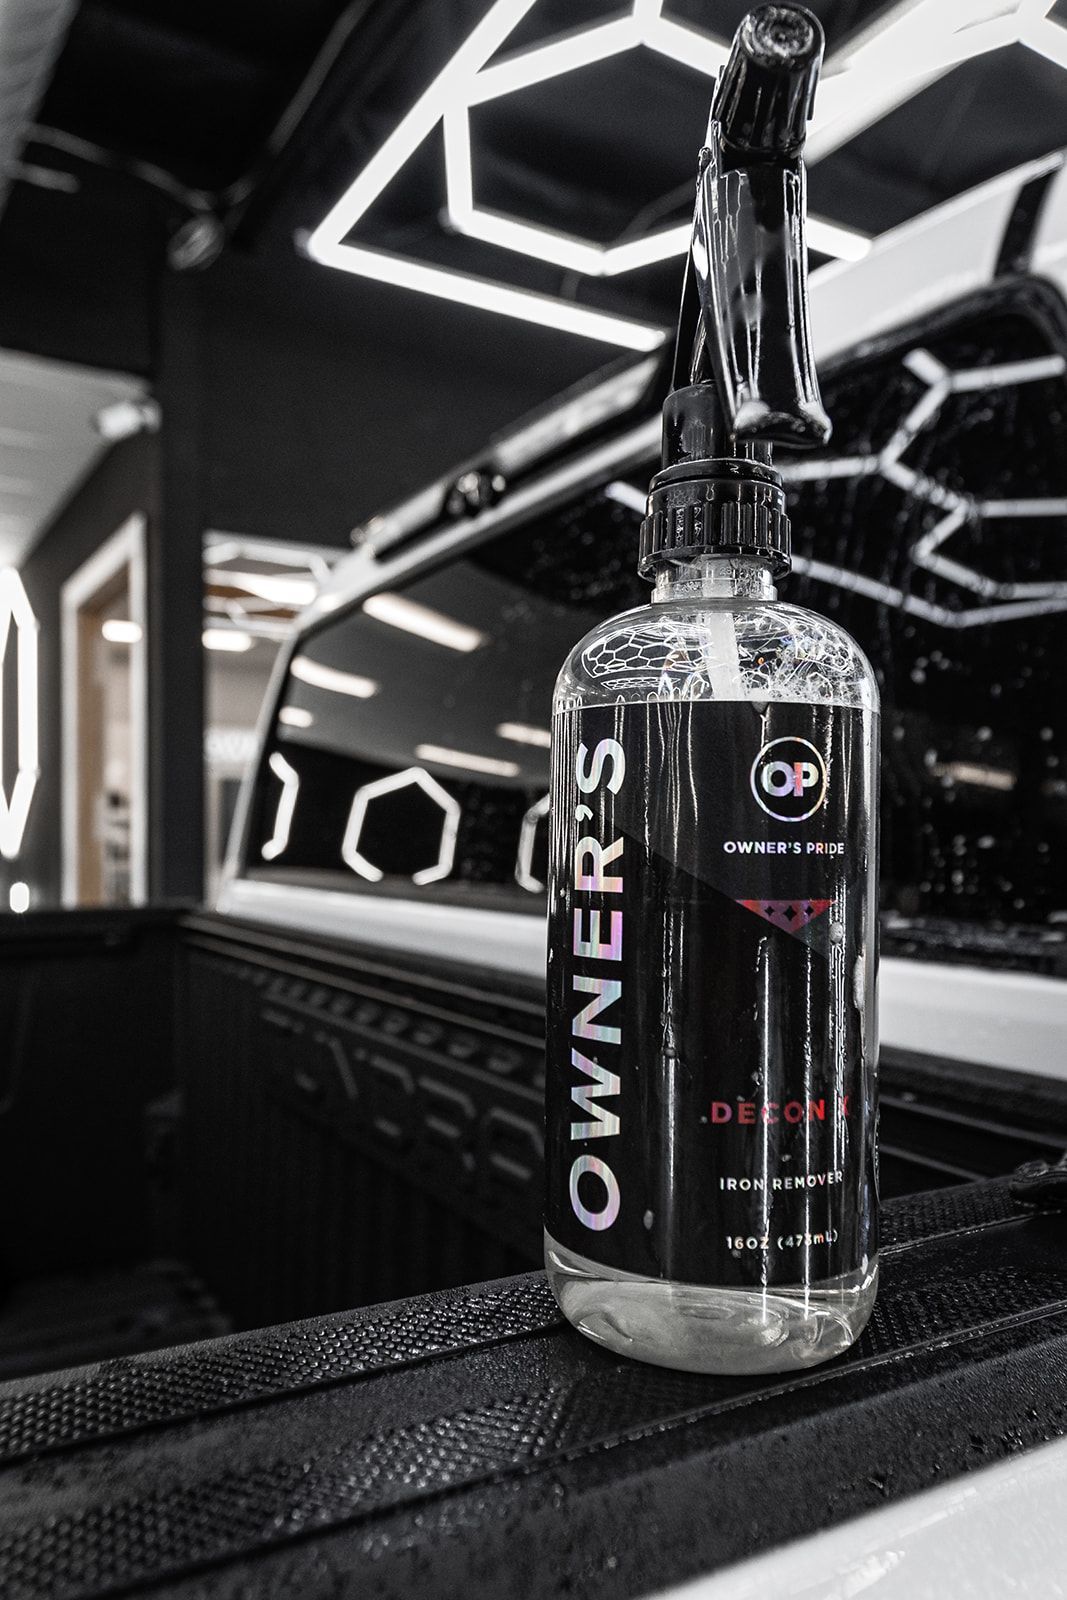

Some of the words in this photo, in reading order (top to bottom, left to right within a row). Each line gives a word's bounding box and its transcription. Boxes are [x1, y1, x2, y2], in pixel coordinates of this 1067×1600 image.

[761, 761, 819, 797] OP
[723, 841, 802, 855] OWNER'S
[806, 842, 845, 855] PRIDE
[569, 737, 626, 1232] OWNER'S
[711, 1099, 825, 1124] DECON
[719, 1176, 764, 1191] IRON
[772, 1171, 843, 1190] REMOVER
